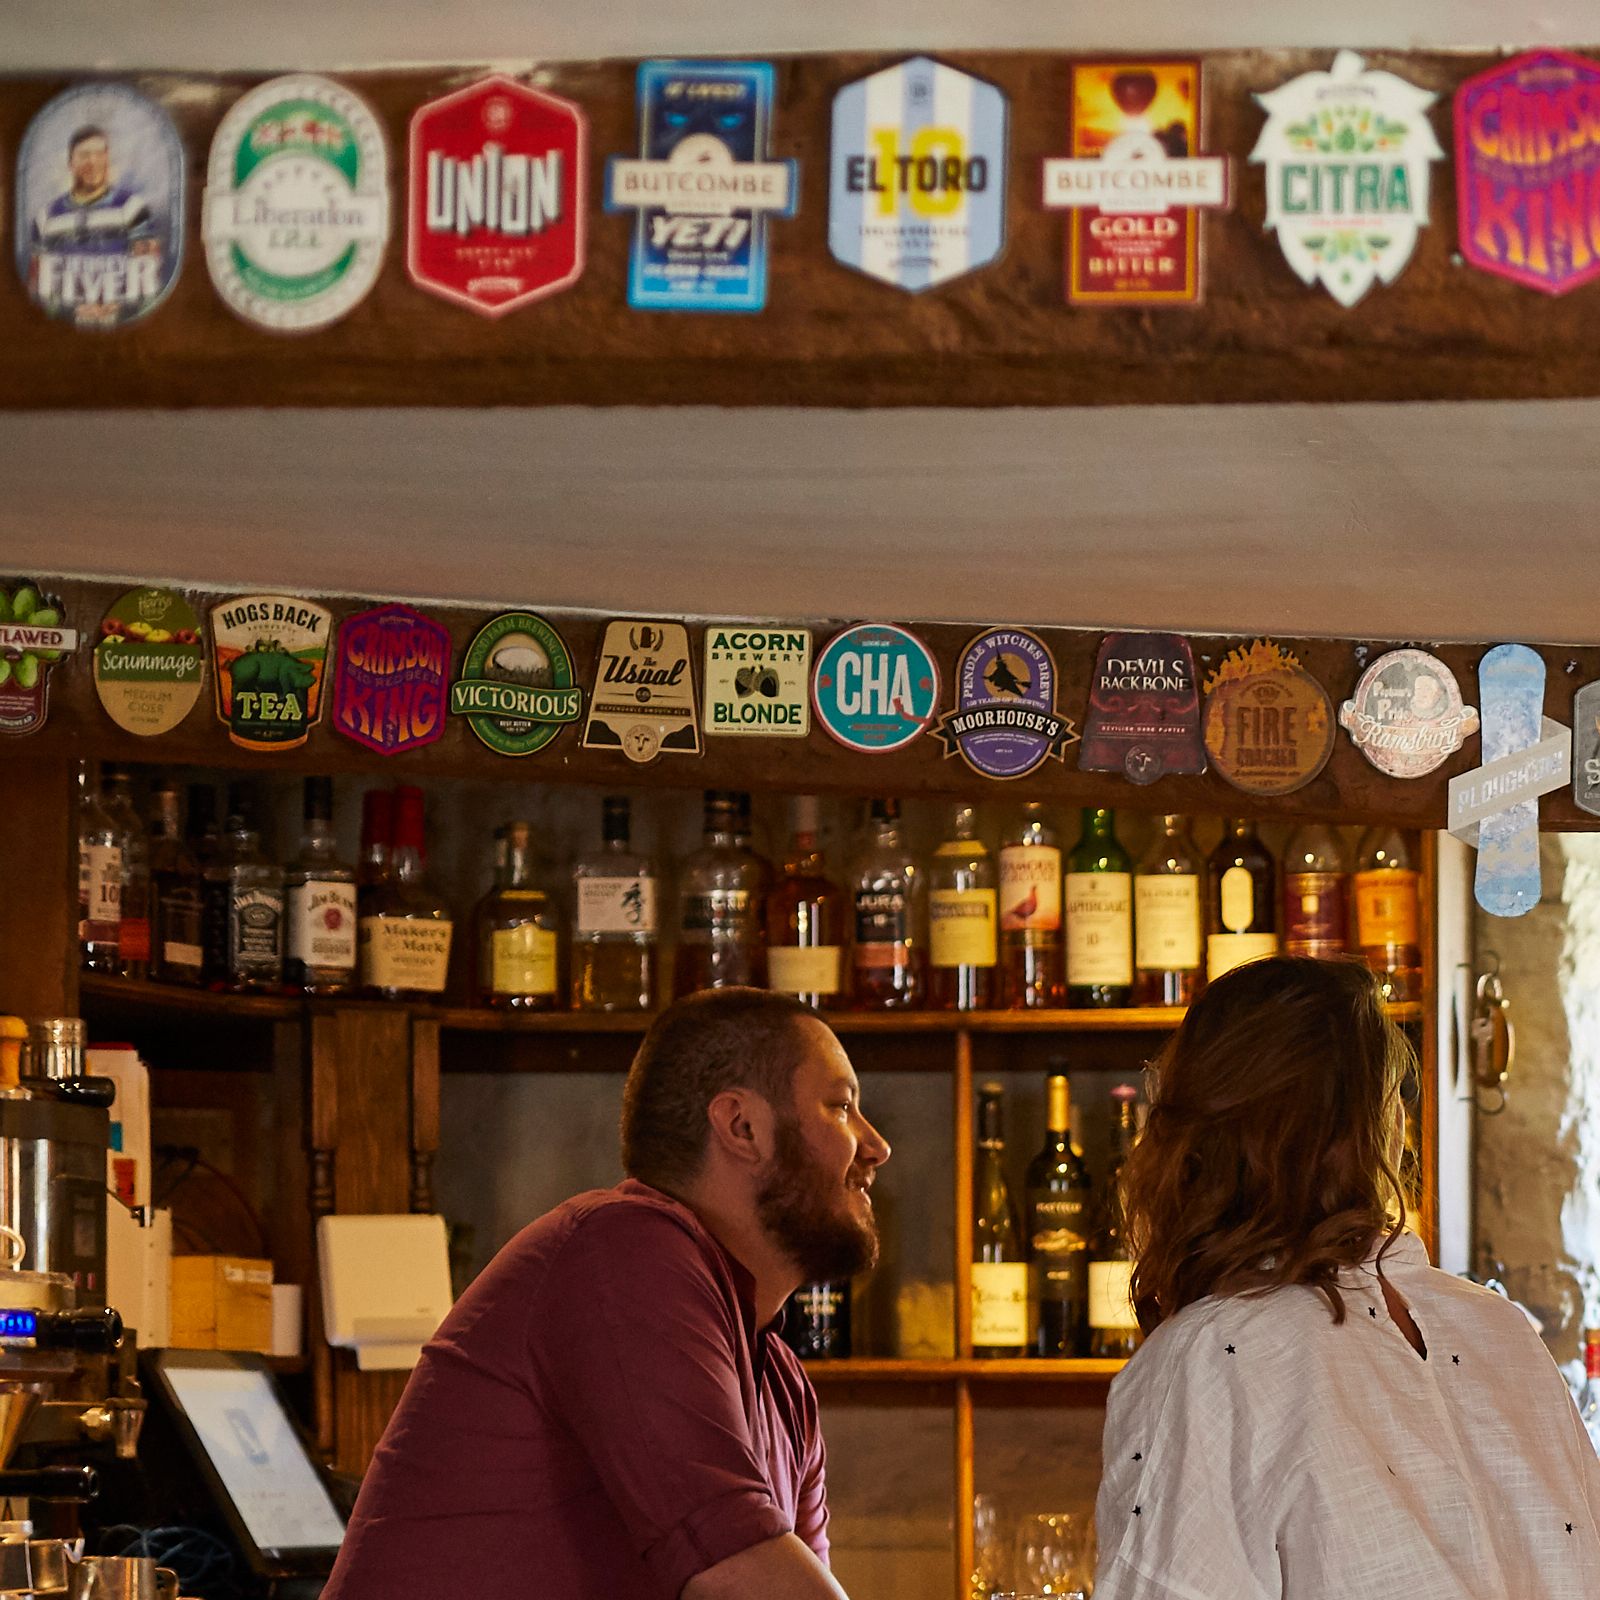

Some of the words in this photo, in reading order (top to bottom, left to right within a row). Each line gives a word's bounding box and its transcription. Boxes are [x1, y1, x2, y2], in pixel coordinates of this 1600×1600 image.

[624, 169, 775, 195] BUTCOMBE
[847, 155, 885, 193] EL
[896, 155, 988, 193] TORO
[1056, 168, 1210, 191] BUTCOMBE
[1281, 162, 1414, 215] CITRA
[426, 141, 561, 237] UNION
[650, 216, 748, 248] YETI
[1090, 217, 1178, 237] GOLD
[222, 603, 270, 631] HOGS
[273, 603, 322, 632] BACK
[346, 626, 442, 675] CRIMSON
[712, 632, 805, 651] ACORN
[102, 650, 198, 678] Scrummage
[603, 654, 688, 686] Usual
[642, 657, 657, 667] The
[712, 652, 804, 662] BREWERY
[962, 645, 986, 698] PENDLE
[986, 634, 1044, 661] WITCHES
[1037, 659, 1051, 701] BREW
[1107, 658, 1184, 676] DEVILS
[124, 689, 172, 700] MEDIUM
[836, 650, 914, 716] CHA
[340, 684, 440, 744] KING
[455, 686, 578, 716] VICTORIOUS
[714, 703, 802, 724] BLONDE
[952, 708, 1060, 737] MOORHOUSE'S
[1236, 706, 1299, 745] FIRE
[1360, 720, 1462, 753] Ramsbury
[403, 941, 446, 953] Mark
